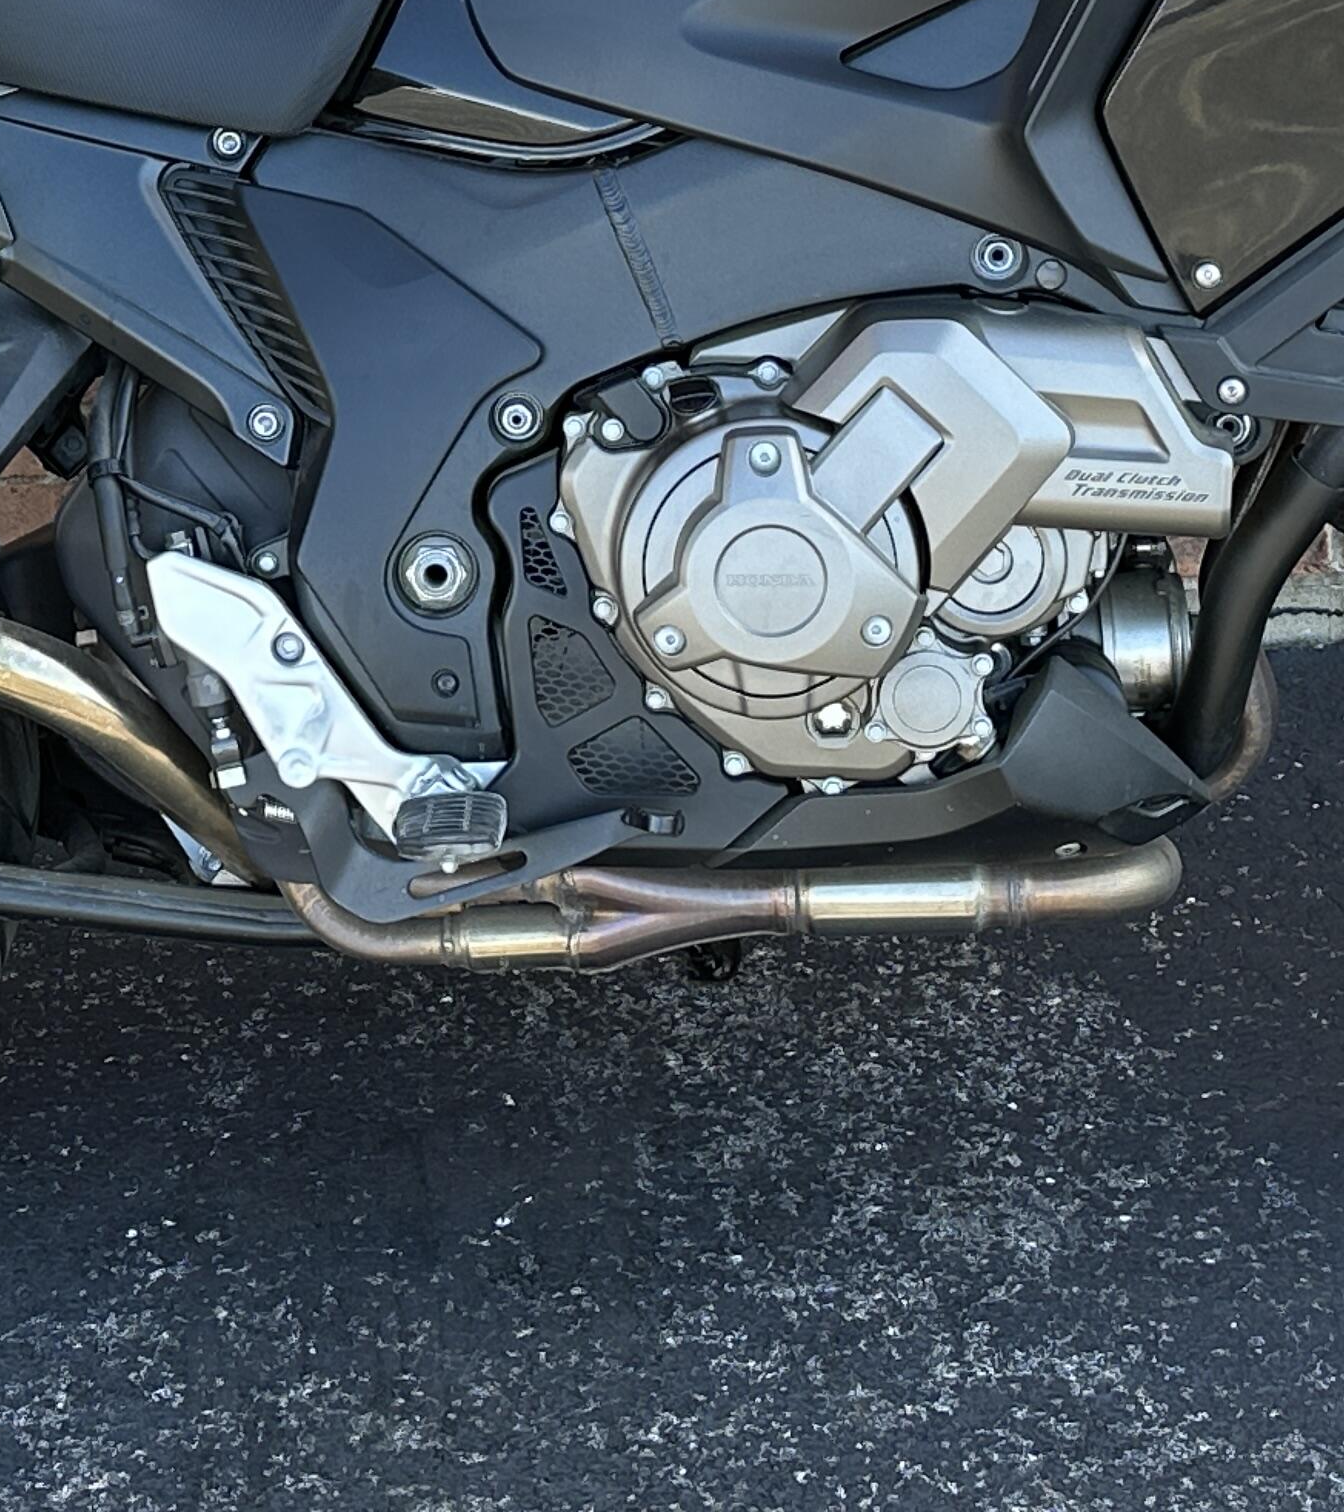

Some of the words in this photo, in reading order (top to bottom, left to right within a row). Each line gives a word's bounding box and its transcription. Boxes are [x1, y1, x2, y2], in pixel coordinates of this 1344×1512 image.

[1064, 469, 1113, 483] Dual
[1116, 471, 1182, 487] Clutch
[1071, 483, 1210, 503] Transmission
[726, 574, 816, 587] HONDA
